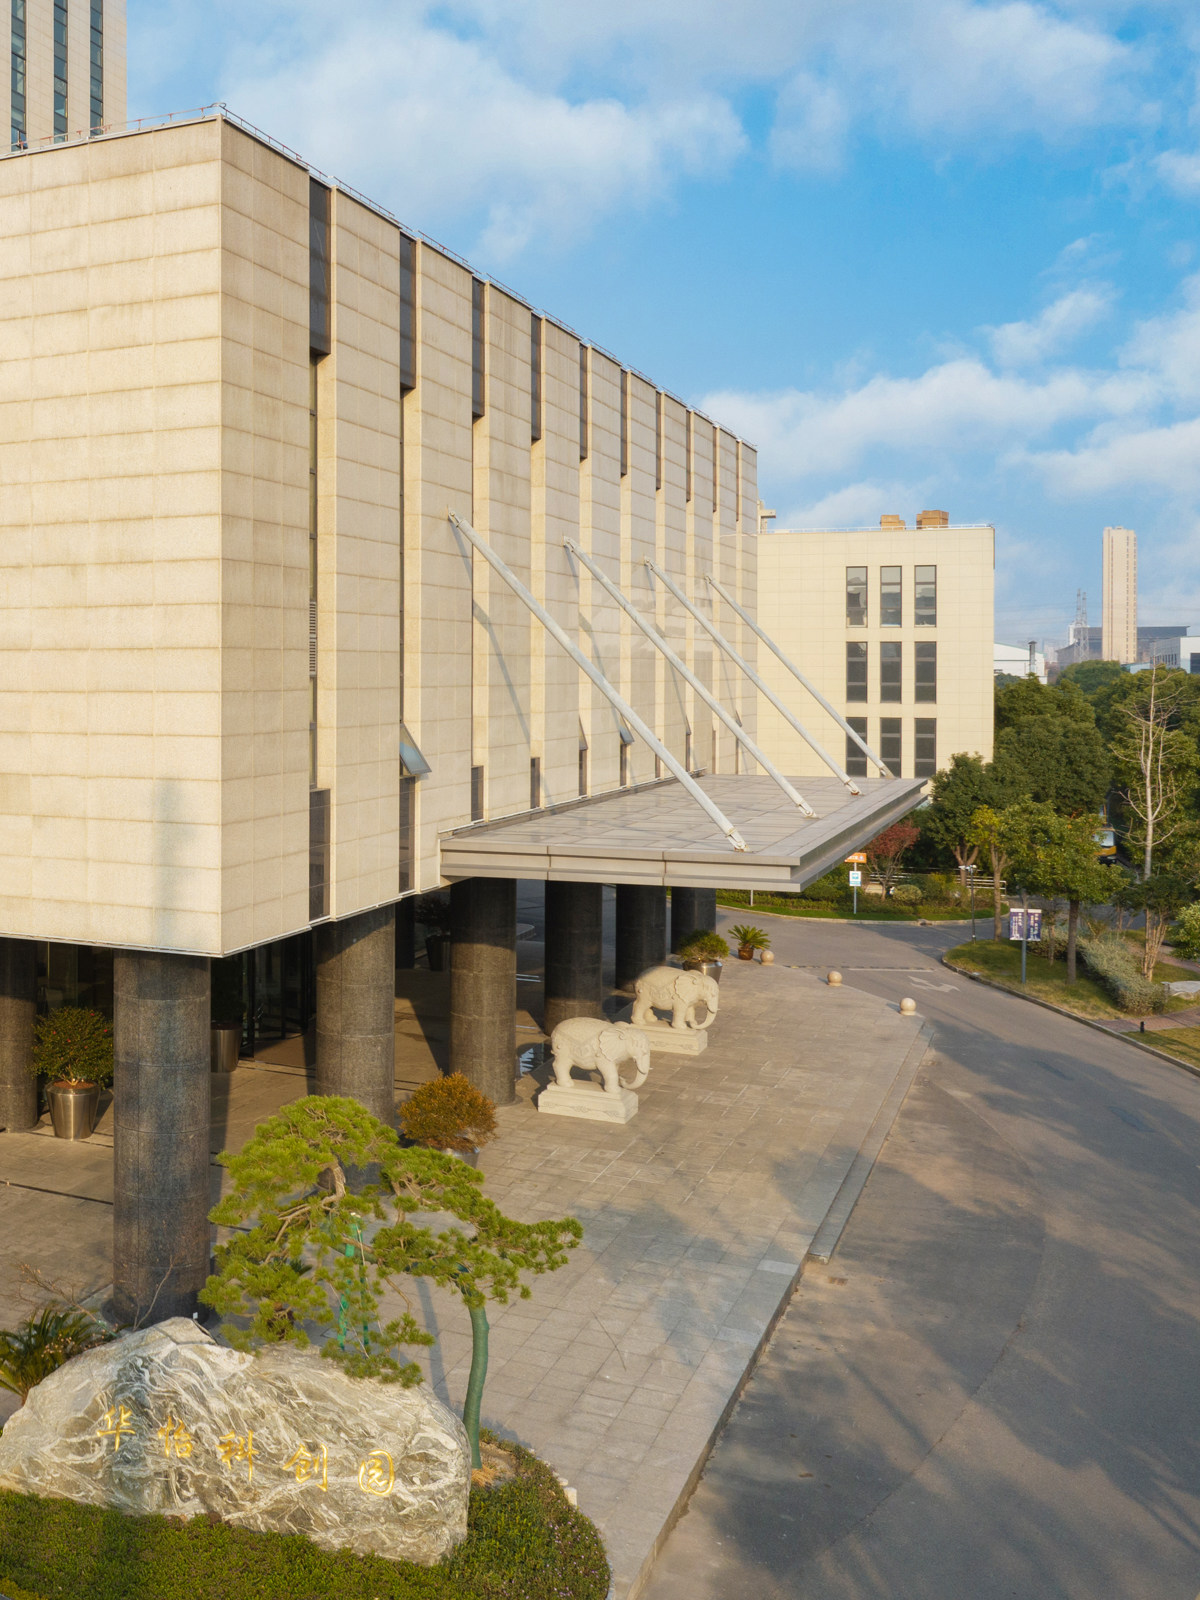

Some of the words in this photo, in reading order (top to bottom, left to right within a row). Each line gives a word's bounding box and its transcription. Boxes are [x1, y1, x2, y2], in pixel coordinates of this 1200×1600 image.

[96, 1404, 395, 1496] 华怡科创园
